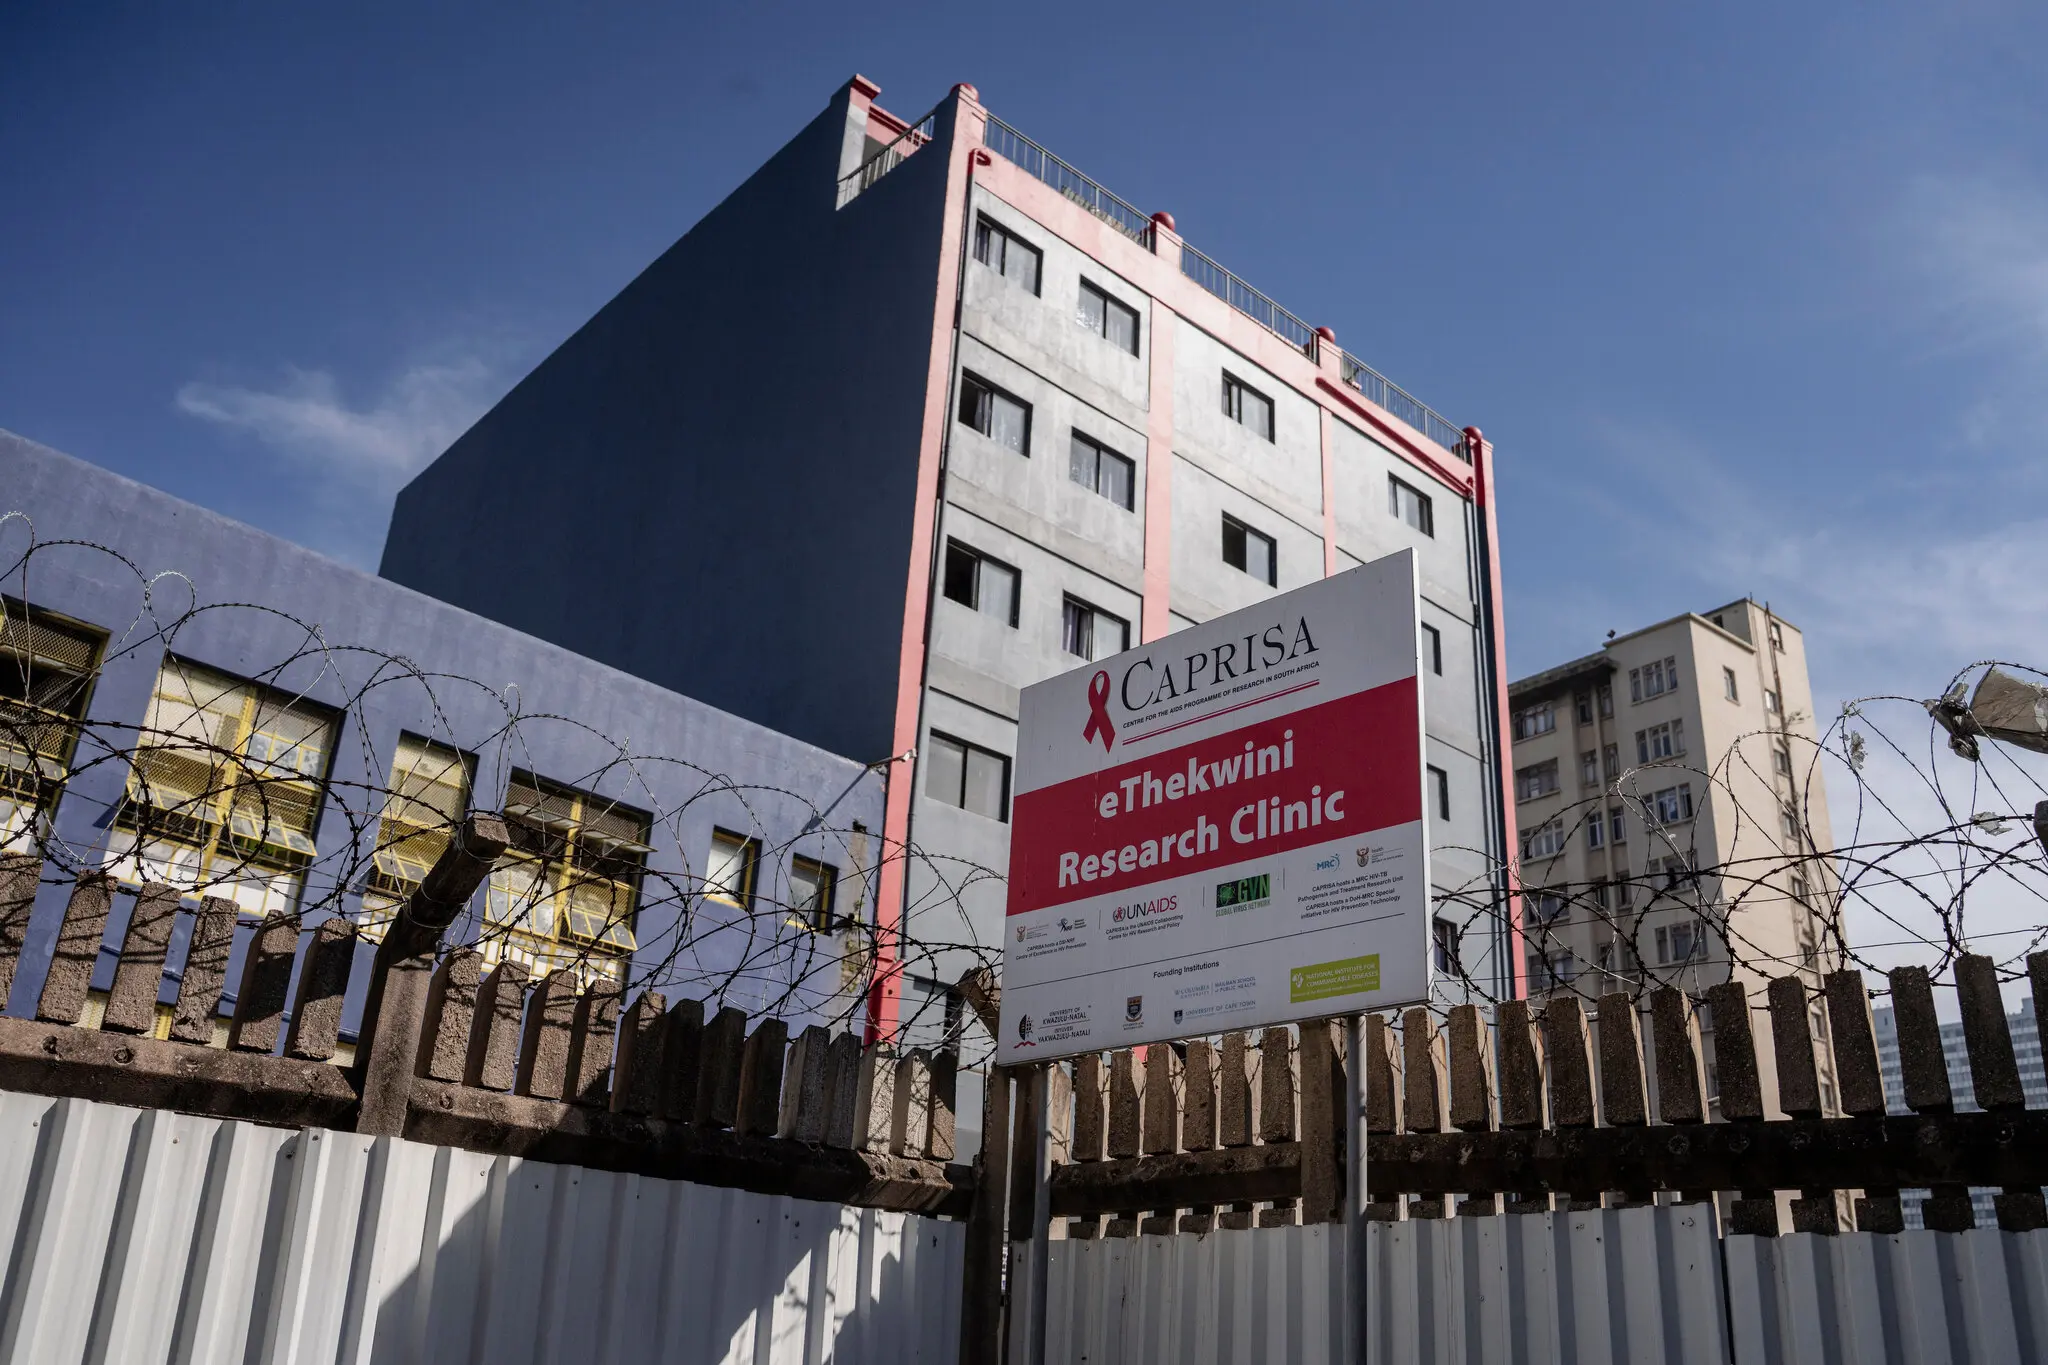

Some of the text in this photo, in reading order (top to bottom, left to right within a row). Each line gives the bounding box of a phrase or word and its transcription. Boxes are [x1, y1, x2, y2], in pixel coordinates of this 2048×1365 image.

[1122, 616, 1319, 710] CAPRISA
[1123, 717, 1144, 728] CENTRE
[1146, 713, 1156, 721] FOR
[1158, 709, 1168, 718] THE
[1170, 705, 1182, 714] AIDS
[1184, 692, 1221, 709] PROGRAMME
[1233, 679, 1264, 694] RESEARCH
[1274, 670, 1294, 681] SOUTH
[1296, 661, 1320, 674] AFRICA
[1100, 729, 1294, 818] eThekwini
[1058, 785, 1344, 888] Research Clinic
[1317, 860, 1334, 870] MRC
[1238, 873, 1270, 903] GVN
[1312, 883, 1336, 892] CAPRISA
[1369, 871, 1387, 880] HIV-TB
[1340, 884, 1366, 893] Treatment
[1367, 879, 1391, 888] Research
[1127, 895, 1177, 919] UNAIDS
[1306, 902, 1329, 910] CAPRISA
[1350, 891, 1374, 902] DoH-MRC
[1376, 888, 1395, 897] Special
[1341, 900, 1369, 911] Prevention
[1370, 895, 1400, 905] Technology
[1216, 909, 1232, 917] GLOBAL
[1233, 904, 1247, 913] VIRUS
[1155, 915, 1183, 924] Collaborating
[1027, 944, 1044, 952] CAPRISA
[1154, 960, 1219, 978] Founding Institutions
[1043, 1012, 1086, 1024] KWAZULU-NATAL
[1186, 1007, 1213, 1016] UNIVERSITY
[1038, 1029, 1090, 1042] YAKWAZULU-NATALI
